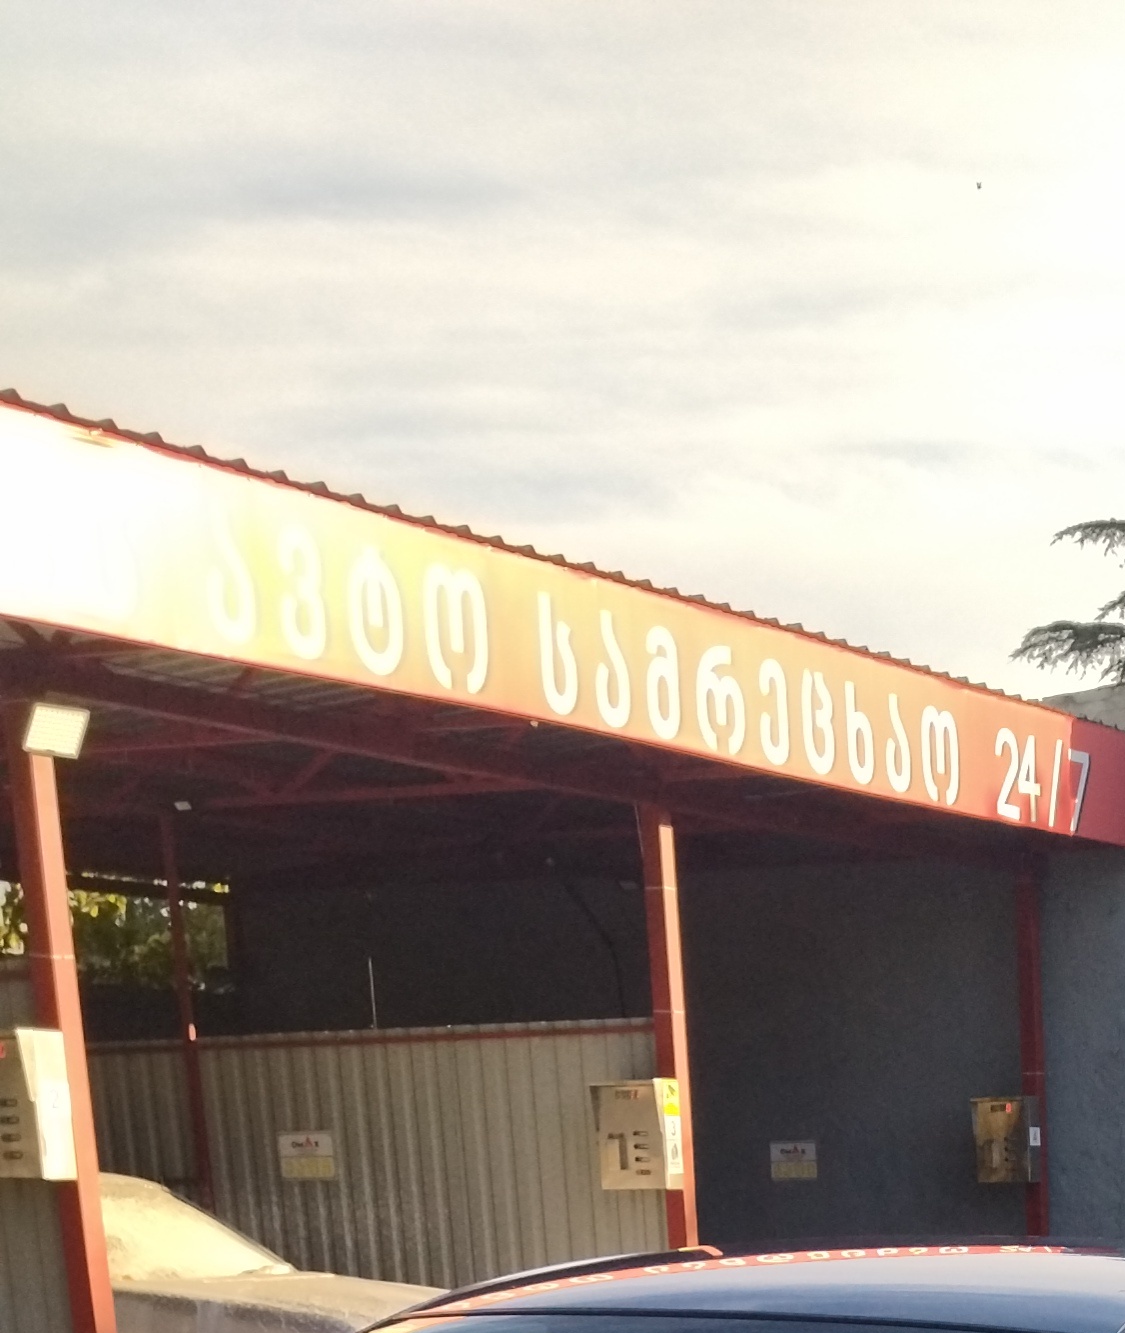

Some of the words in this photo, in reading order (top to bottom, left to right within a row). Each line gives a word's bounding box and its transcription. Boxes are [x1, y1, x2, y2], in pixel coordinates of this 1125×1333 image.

[206, 496, 489, 695] ავტო
[536, 590, 961, 806] სამრეცხაო
[994, 726, 1091, 836] 24/7
